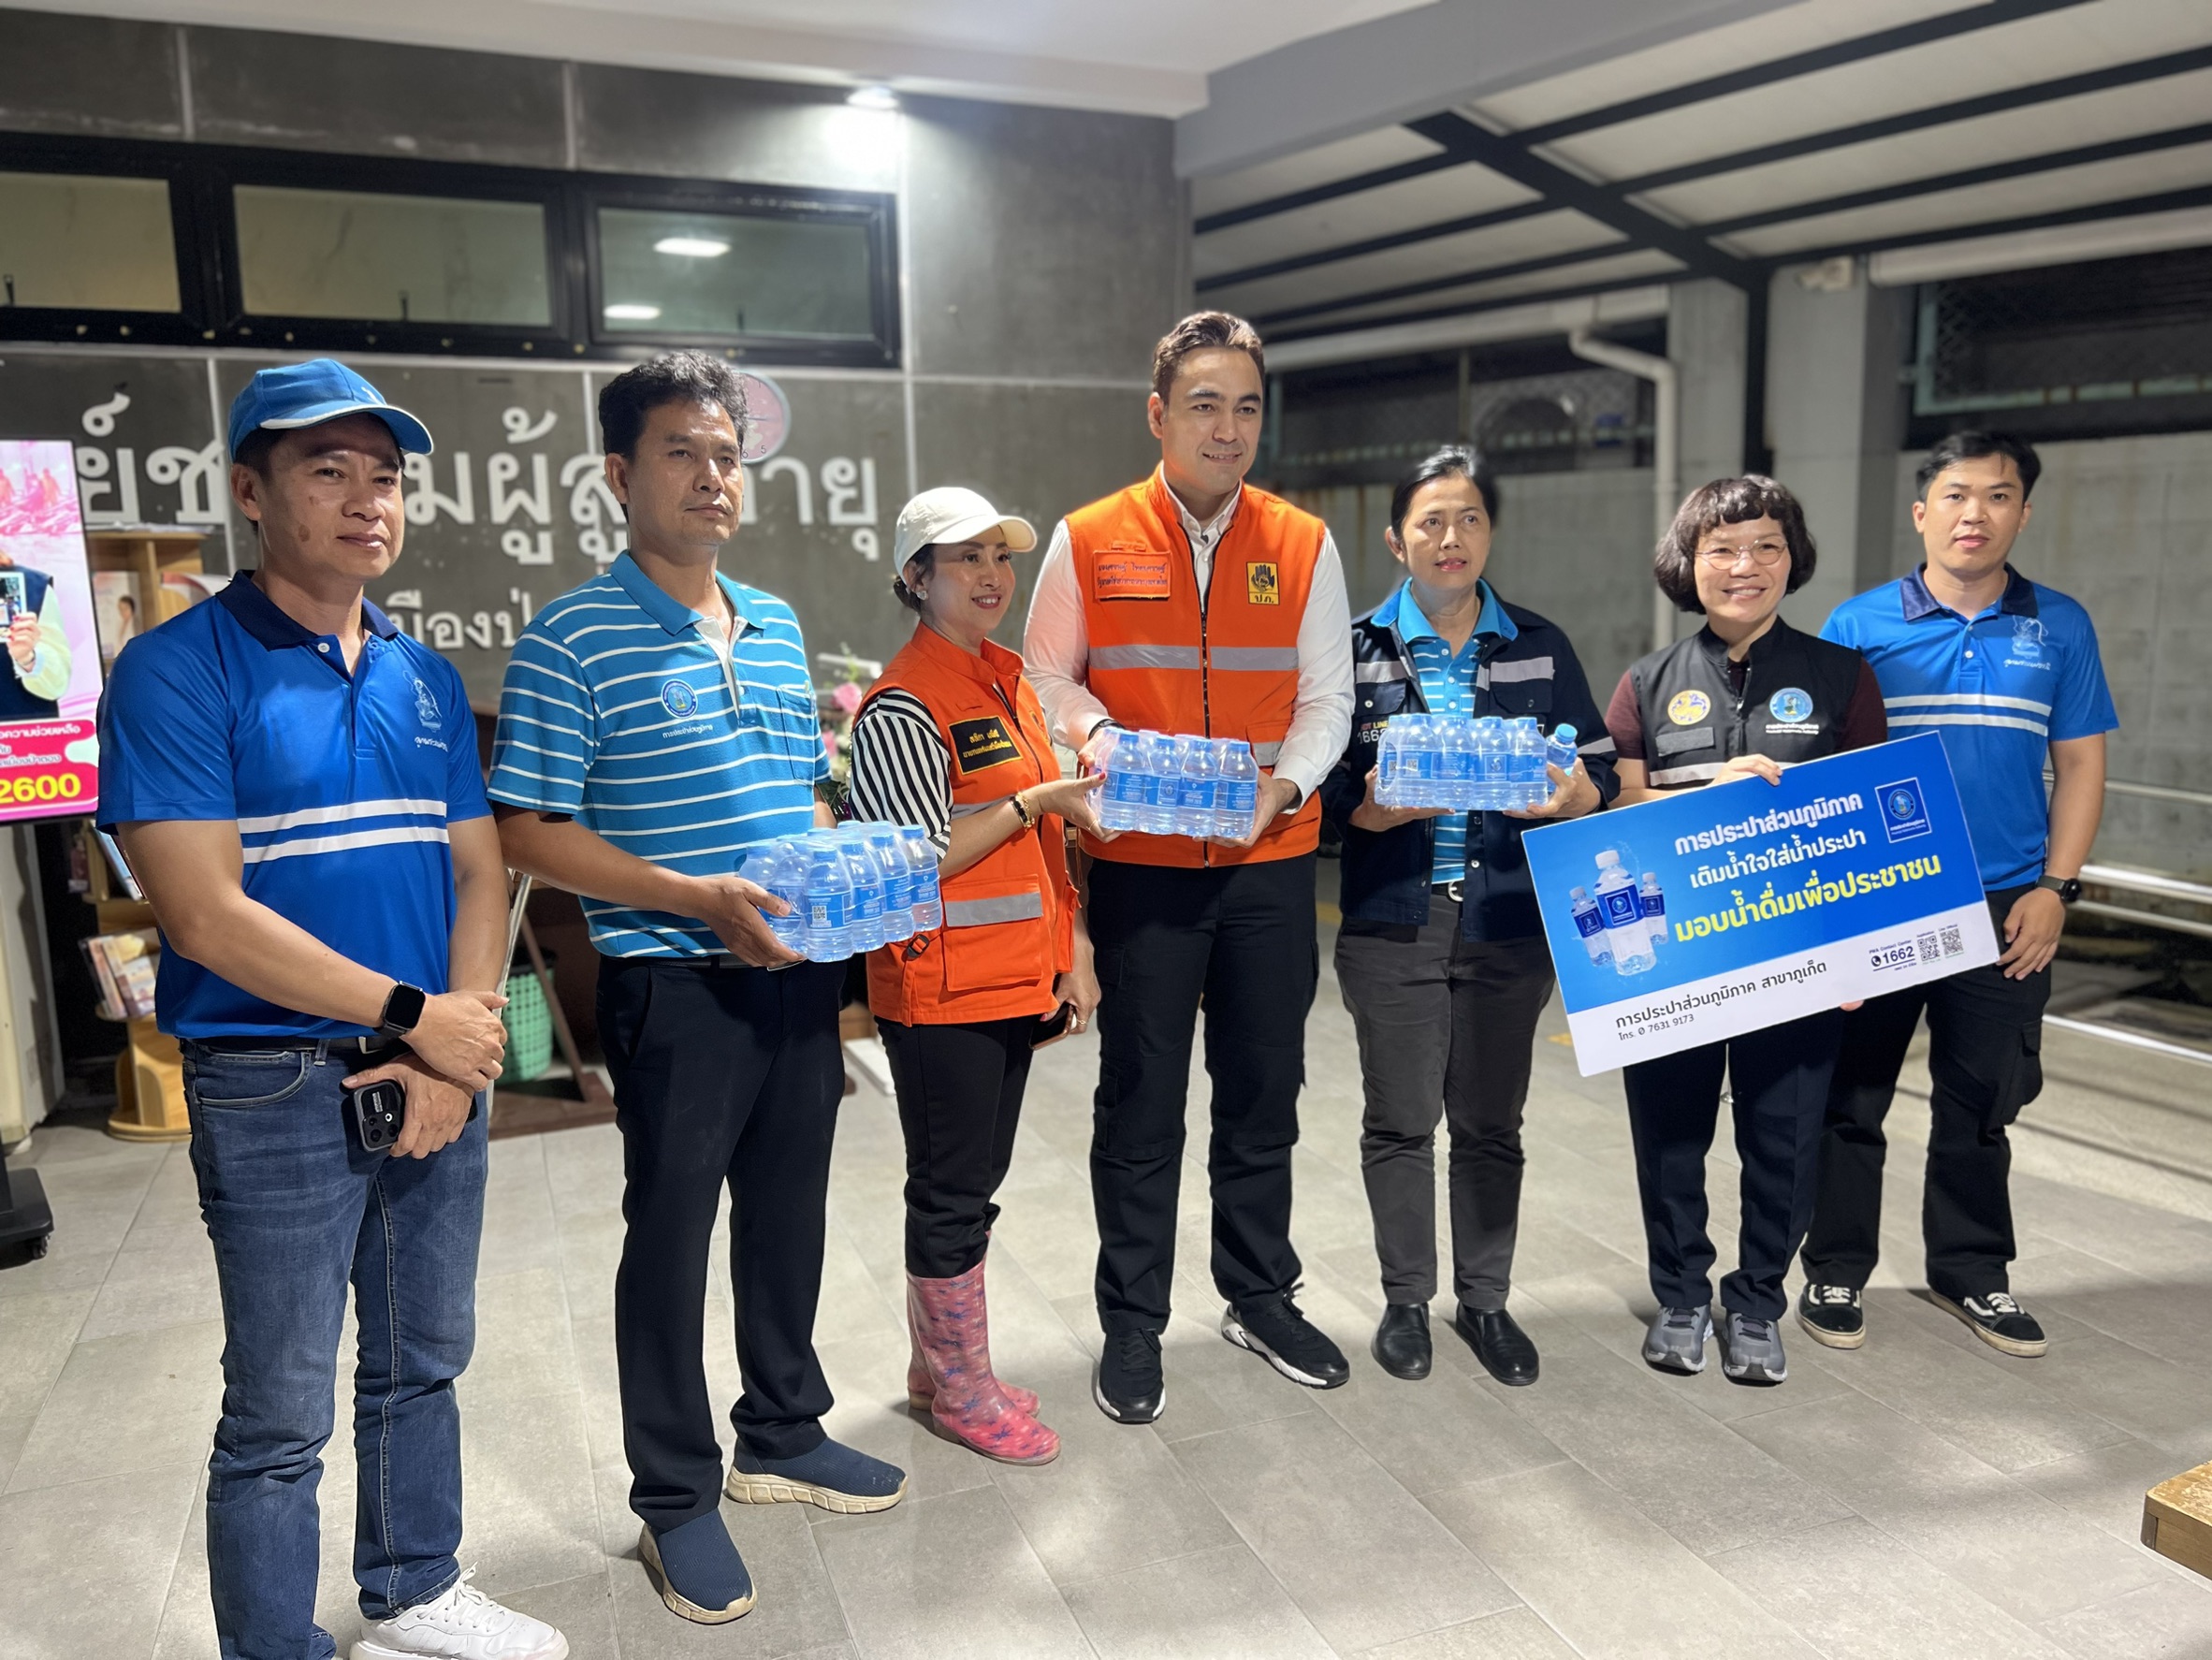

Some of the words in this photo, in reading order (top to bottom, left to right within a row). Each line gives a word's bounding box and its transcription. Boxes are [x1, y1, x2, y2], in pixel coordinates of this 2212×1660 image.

[1675, 794, 1864, 855] การประปาส่วนภูมิภาค
[1690, 829, 1867, 888] เติมน้ำใจใส่น้ำประปา
[1674, 854, 1942, 942] มอบน้ำดื่มเพื่อประชาชน
[1880, 943, 1897, 952] Contact
[1883, 946, 1914, 964] 1662
[1616, 981, 1756, 1027] การประปาส่วนภูมิภาค
[1761, 960, 1826, 988] สาขาภูเก็ต
[1618, 1029, 1636, 1041] โทร.
[1647, 1020, 1670, 1033] 7631
[1673, 1013, 1695, 1027] 9173
